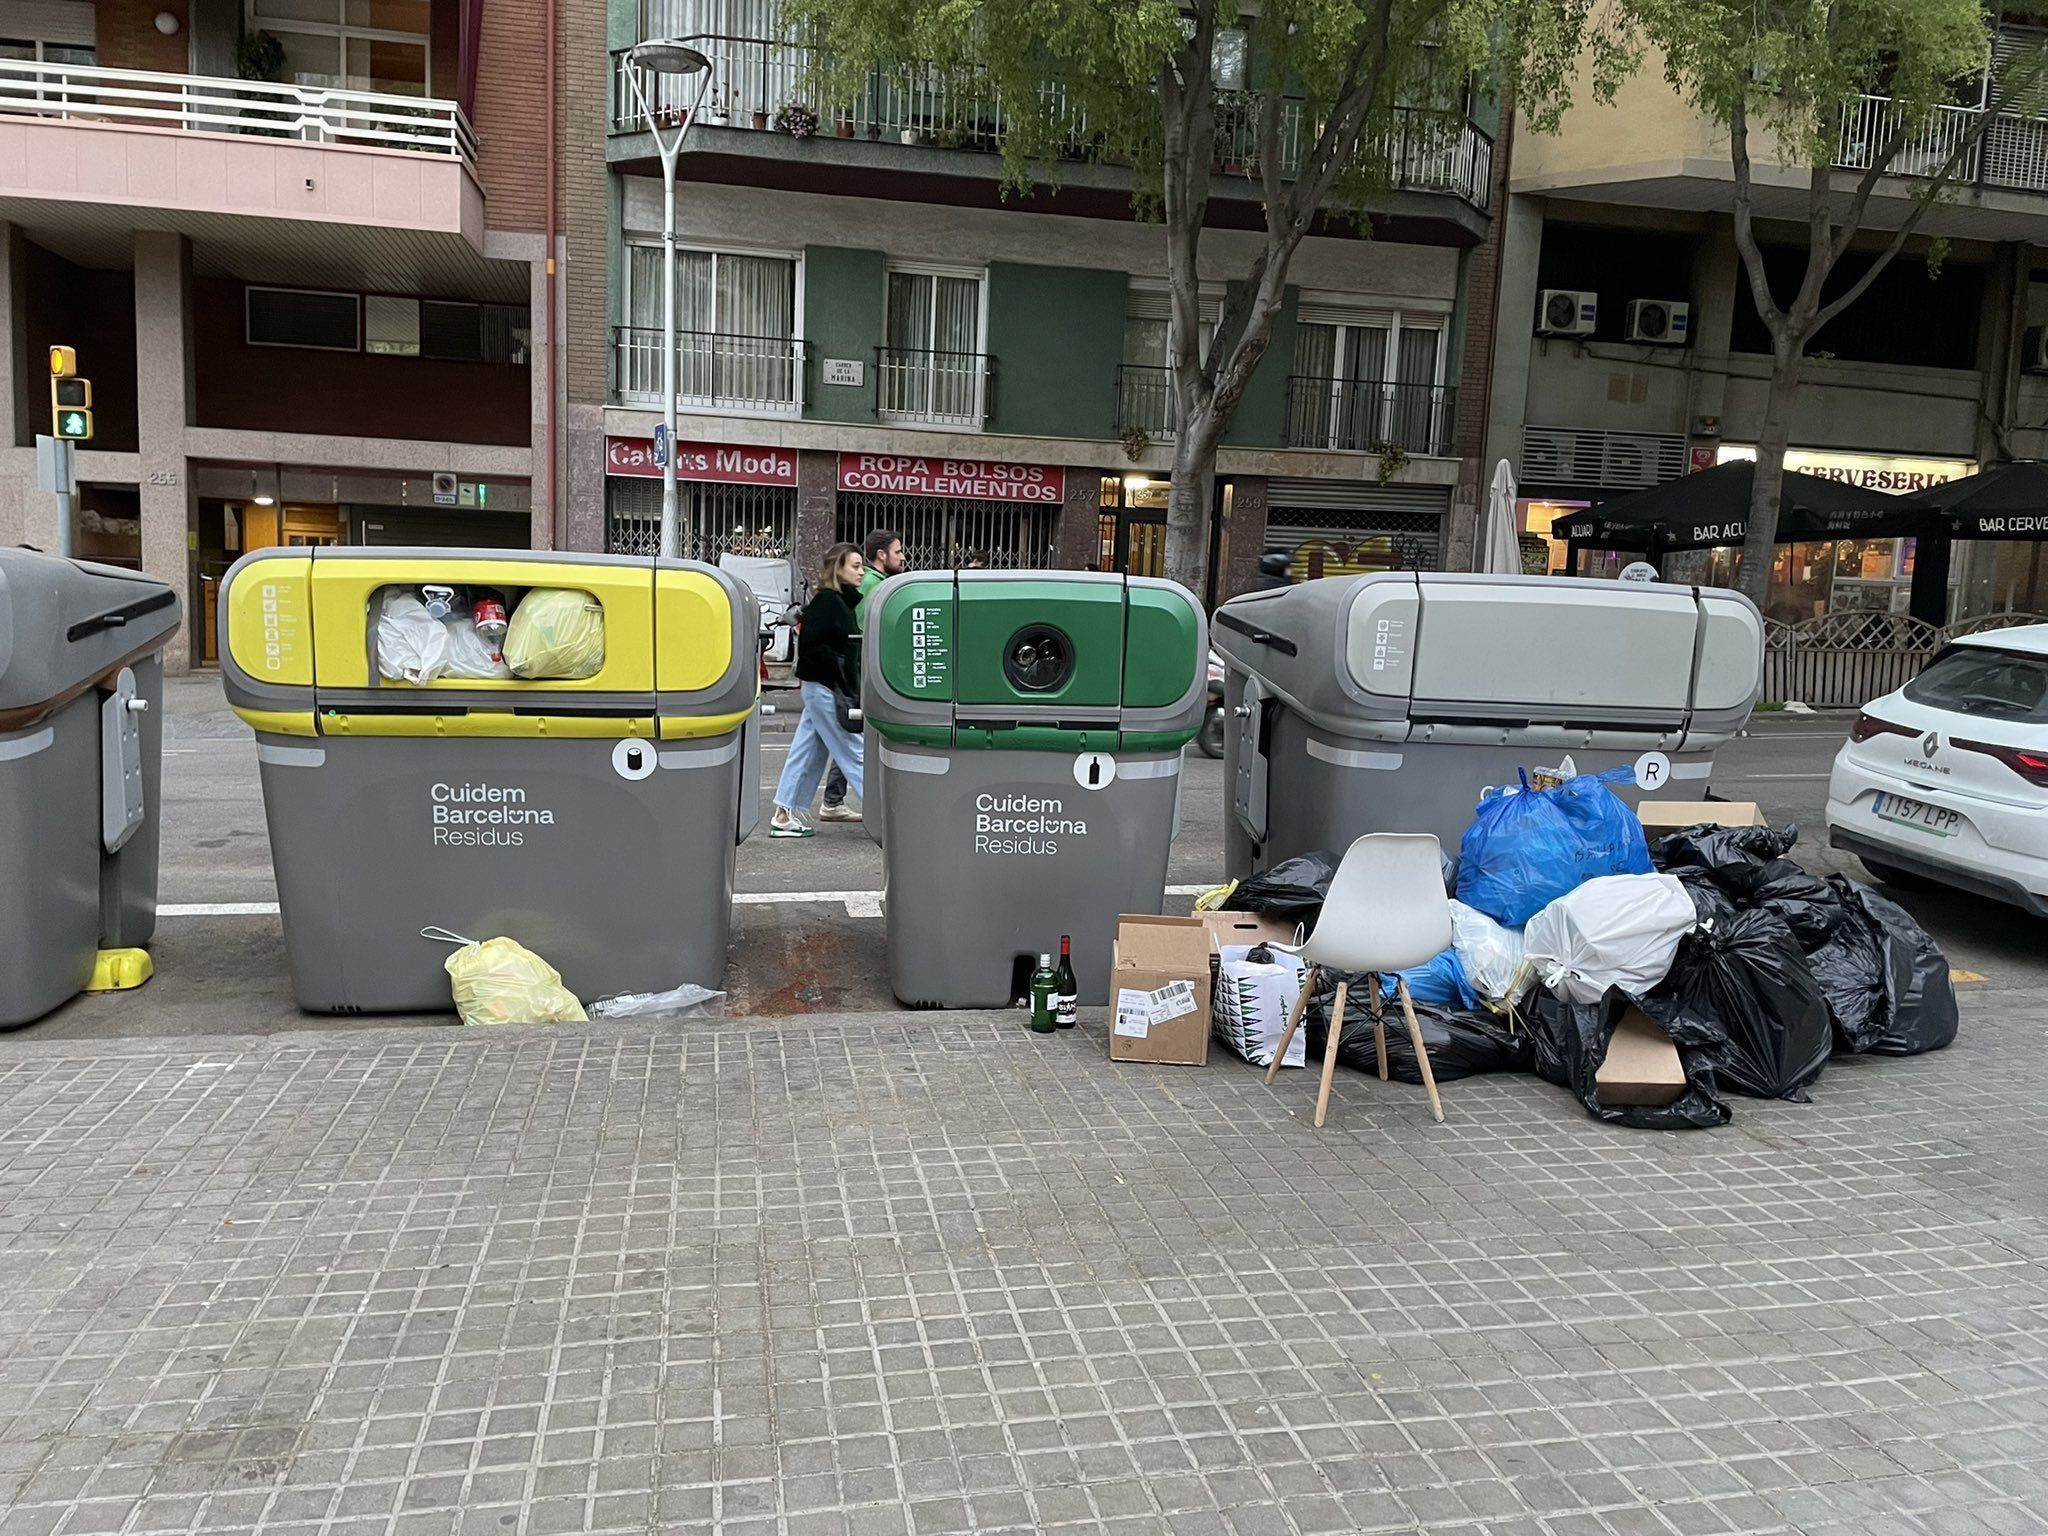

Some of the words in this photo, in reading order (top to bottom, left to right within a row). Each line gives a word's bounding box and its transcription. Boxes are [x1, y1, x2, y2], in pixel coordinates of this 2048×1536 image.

[715, 449, 792, 477] Moda
[859, 455, 930, 475] ROPA
[942, 461, 1044, 482] BOLSOS
[150, 471, 177, 486] 255
[844, 472, 1057, 501] COMPLEMENTOS
[1069, 489, 1096, 501] 257
[1236, 497, 1262, 509] 259
[1693, 524, 1720, 541] BAR
[1722, 521, 1747, 538] ACU
[1979, 517, 2006, 532] BAR
[2008, 516, 2048, 531] CERVE
[1646, 762, 1660, 780] R
[1904, 758, 1951, 775] MEGANE
[431, 782, 526, 803] Cuidem
[975, 793, 1062, 814] Cuidem
[1884, 796, 1922, 819] 1157
[1923, 806, 1958, 830] LPP
[432, 804, 555, 825] Barcelona
[976, 814, 1088, 835] Barcelona
[433, 826, 524, 846] Residus
[975, 835, 1058, 855] Residus
